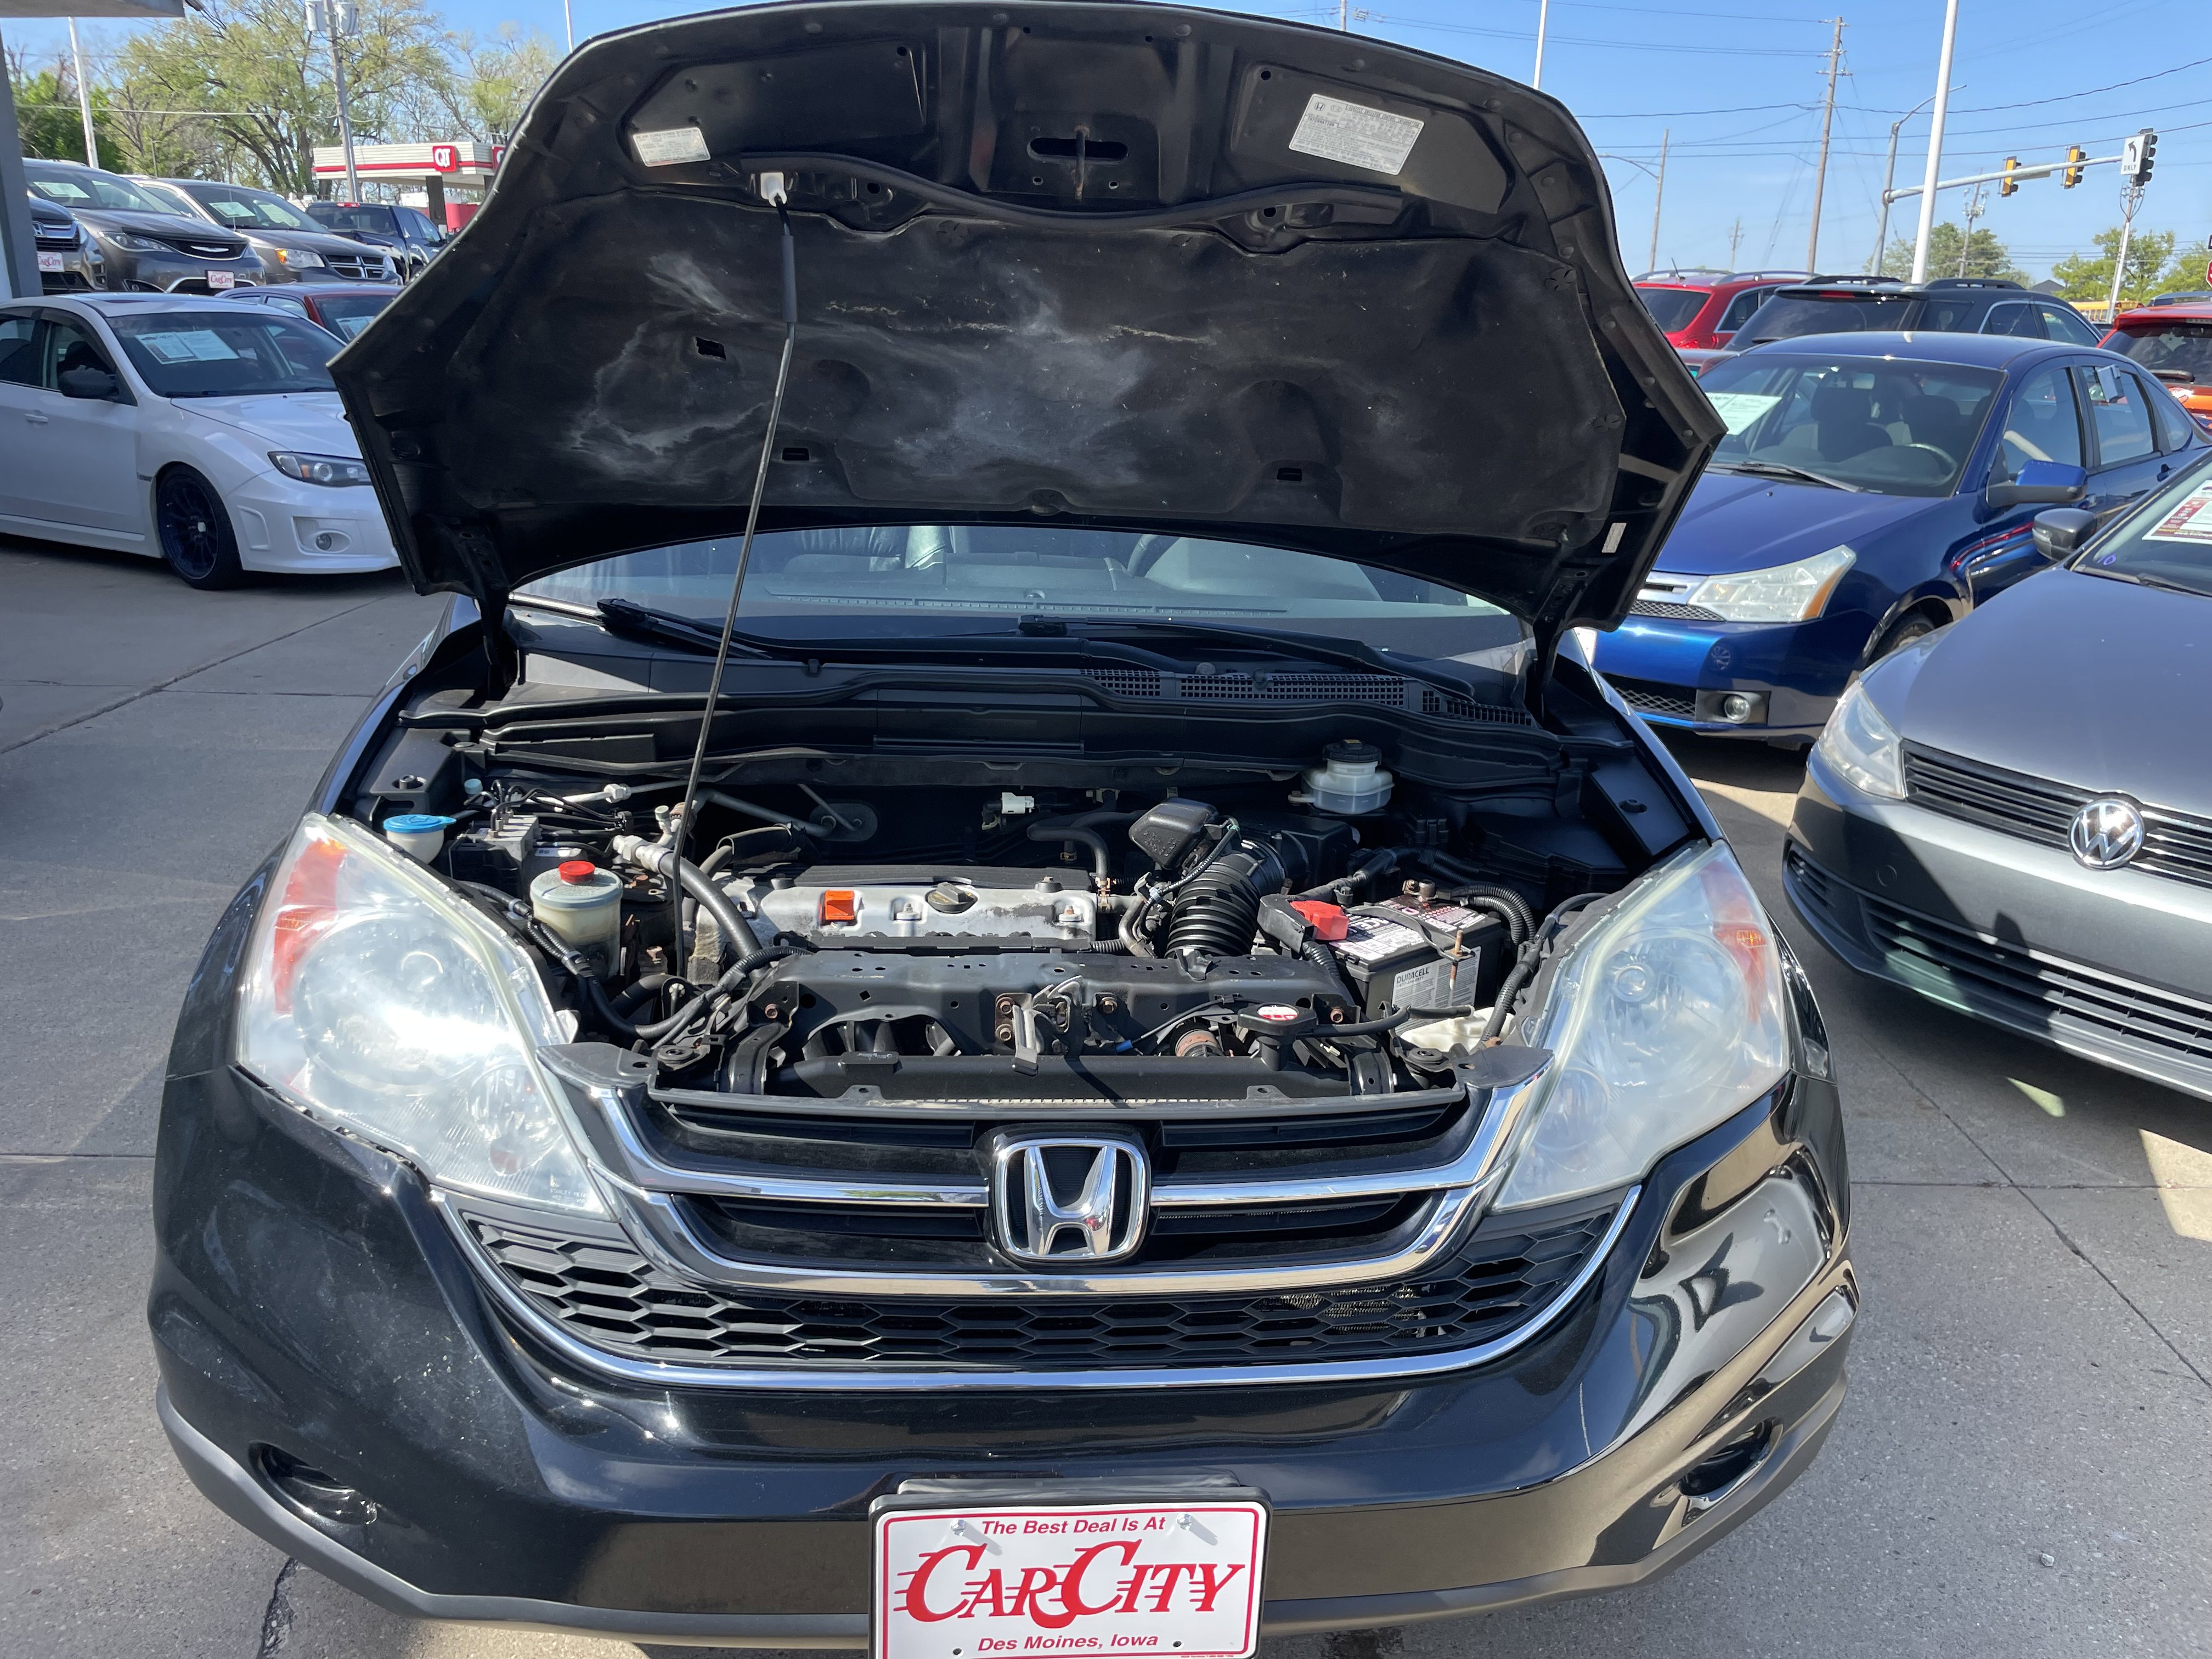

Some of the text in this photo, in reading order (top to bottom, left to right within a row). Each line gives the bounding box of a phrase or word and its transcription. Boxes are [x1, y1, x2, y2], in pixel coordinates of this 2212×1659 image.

[435, 148, 451, 167] QT
[1396, 967, 1429, 984] DURACELL
[982, 1516, 1167, 1534] The Best Deal Is At
[978, 1633, 1159, 1651] Des Moines, Iowa
